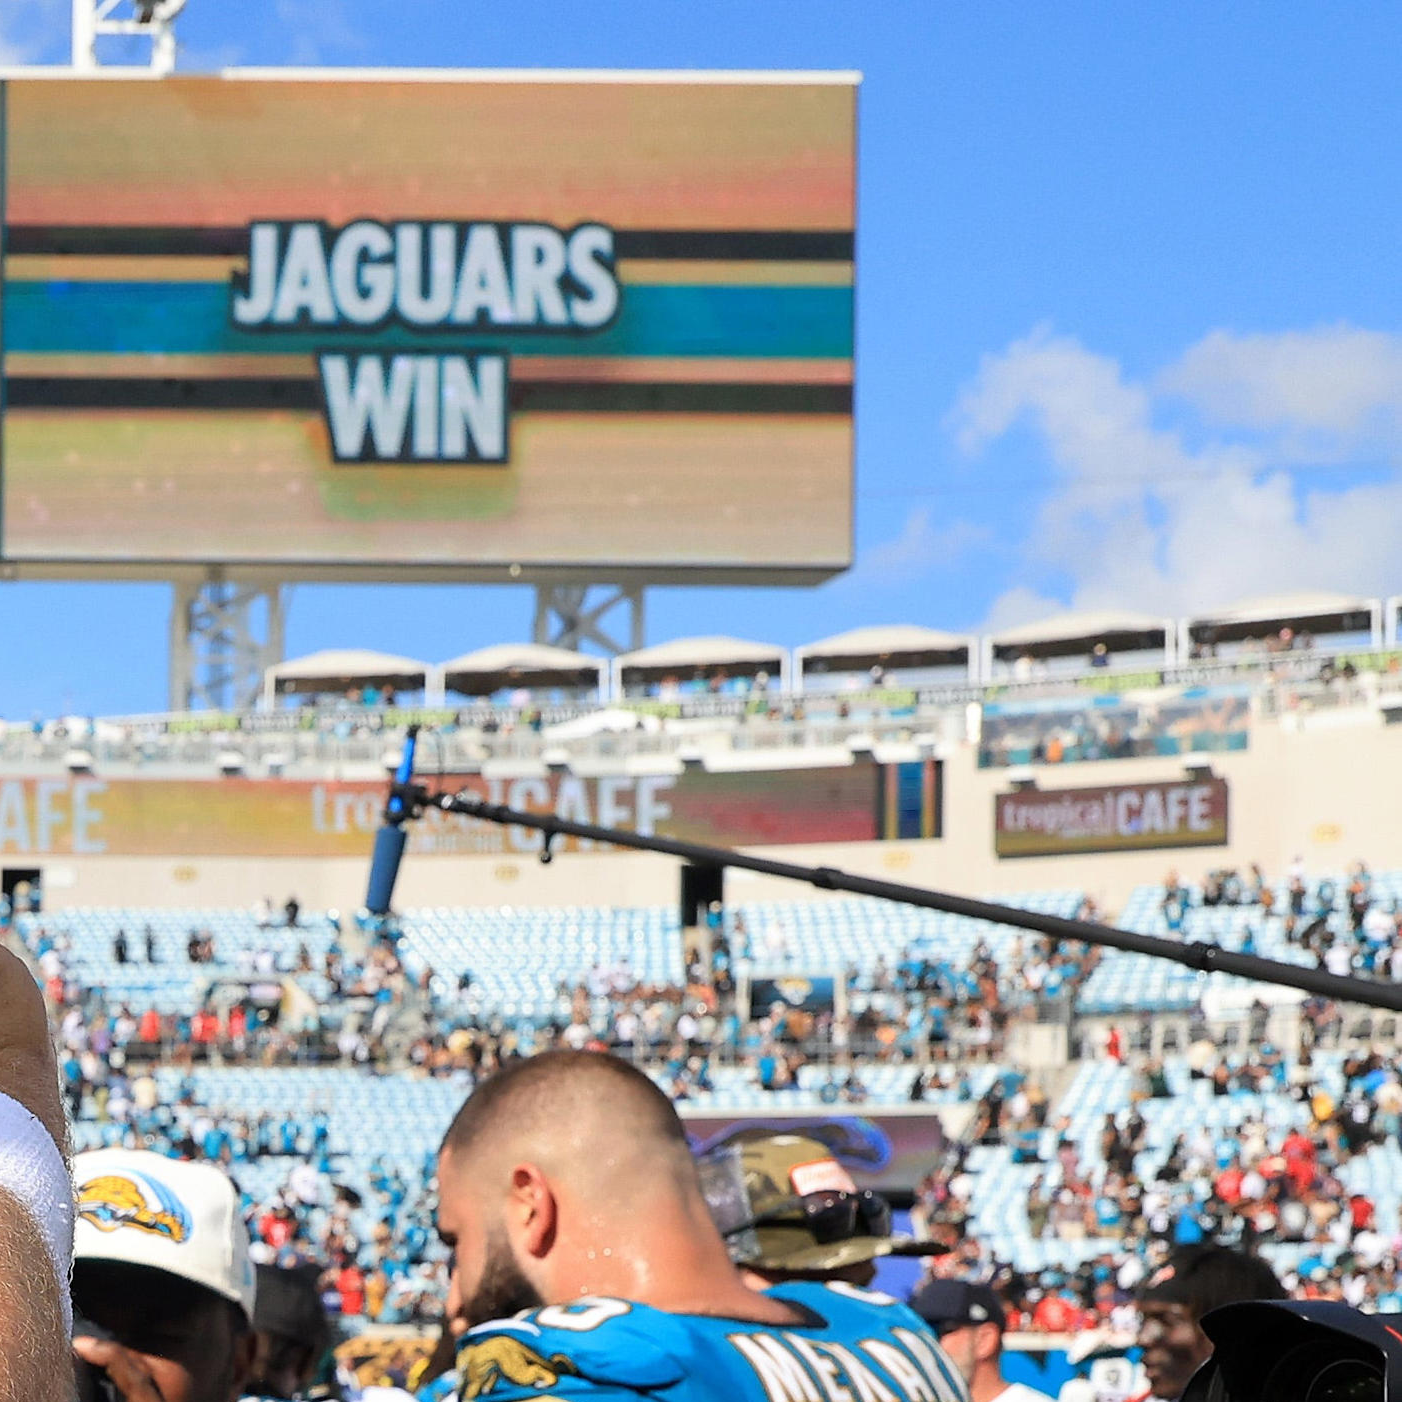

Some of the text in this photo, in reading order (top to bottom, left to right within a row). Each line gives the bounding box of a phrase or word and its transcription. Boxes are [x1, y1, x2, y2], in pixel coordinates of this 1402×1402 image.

[232, 221, 620, 328] JAGUARS
[319, 353, 507, 460] WIN
[1116, 784, 1213, 836] CAFE
